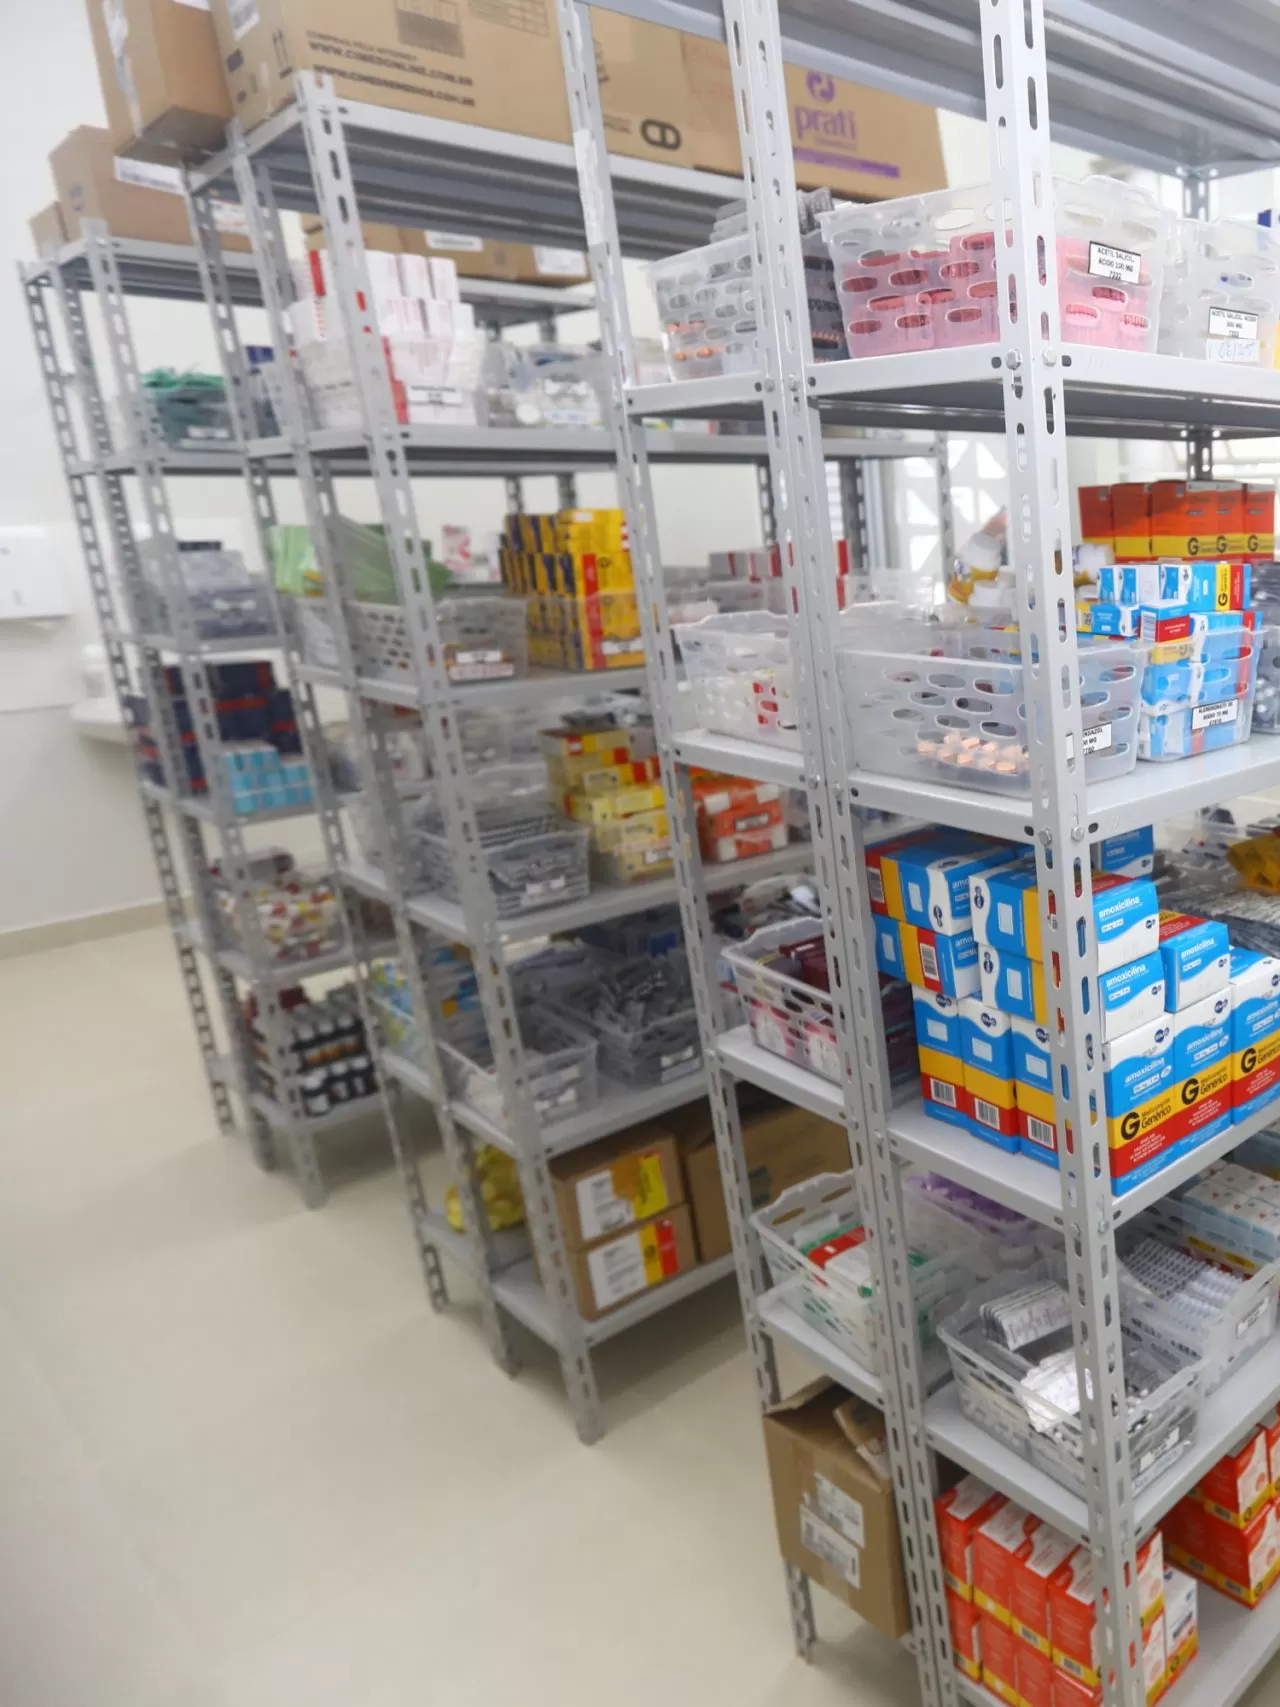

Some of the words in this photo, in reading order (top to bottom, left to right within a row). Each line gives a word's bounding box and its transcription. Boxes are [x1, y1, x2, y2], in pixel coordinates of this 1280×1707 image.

[794, 105, 857, 141] prati
[1187, 536, 1200, 556] G
[1098, 896, 1141, 919] amoxicilina
[1106, 964, 1147, 988] amoxicilina
[1241, 1048, 1257, 1074] G
[1181, 1078, 1200, 1105] G
[1120, 1112, 1141, 1141] G
[1141, 1105, 1172, 1129] Genérico
